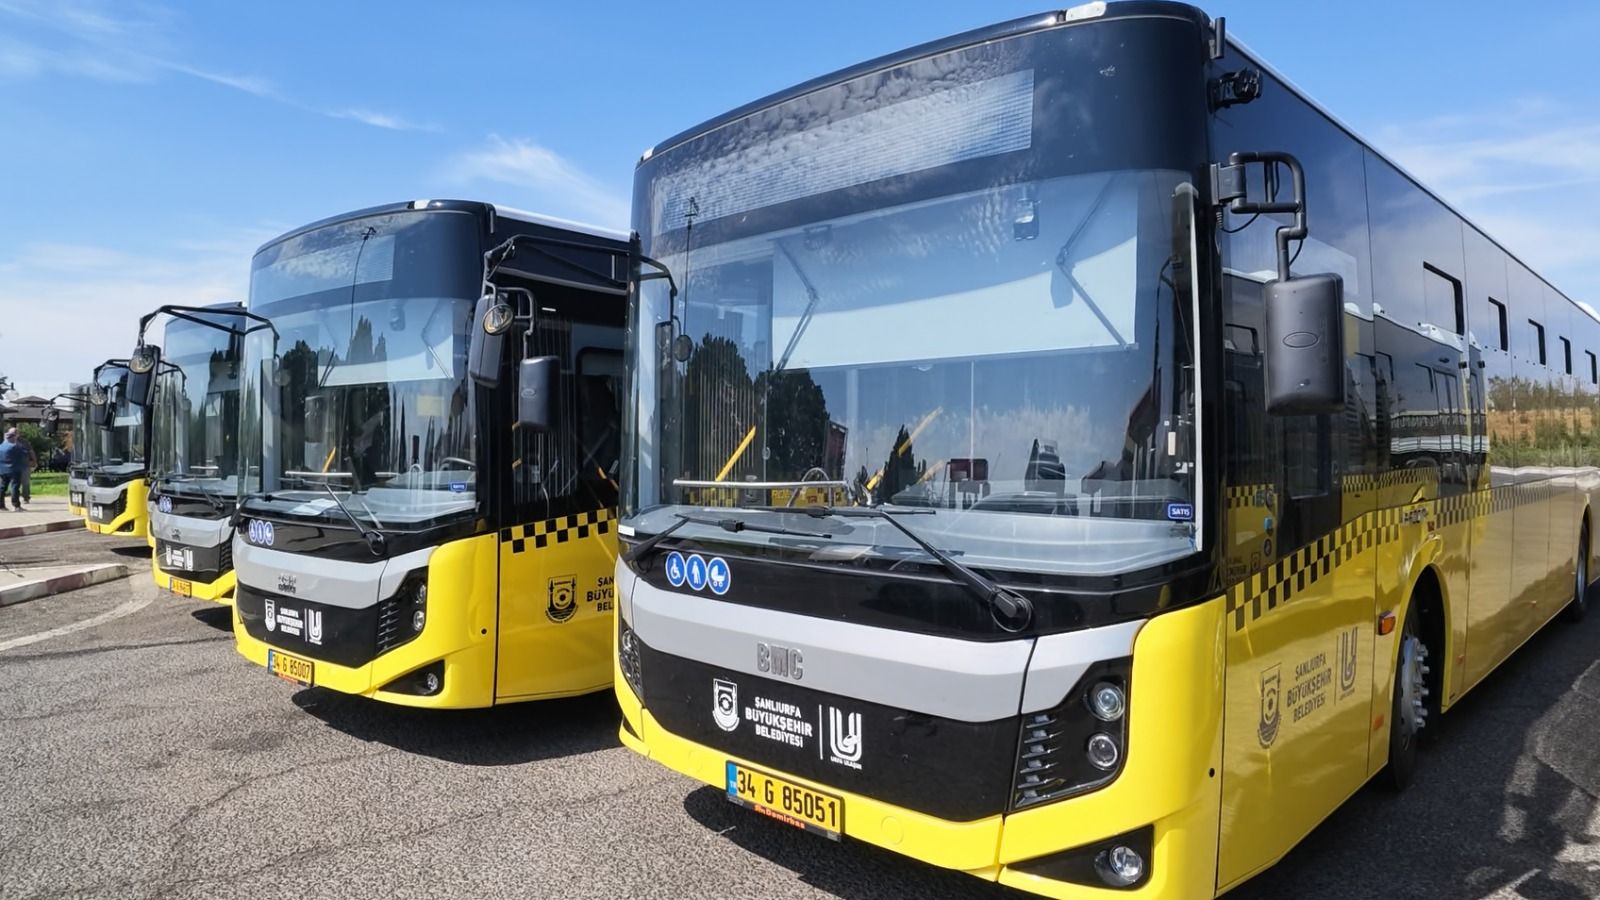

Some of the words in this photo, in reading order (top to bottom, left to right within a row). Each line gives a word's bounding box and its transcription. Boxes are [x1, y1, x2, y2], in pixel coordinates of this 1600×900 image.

[757, 643, 803, 680] BMC
[737, 770, 755, 798] 34
[764, 779, 774, 804] G
[783, 785, 836, 827] 85051
